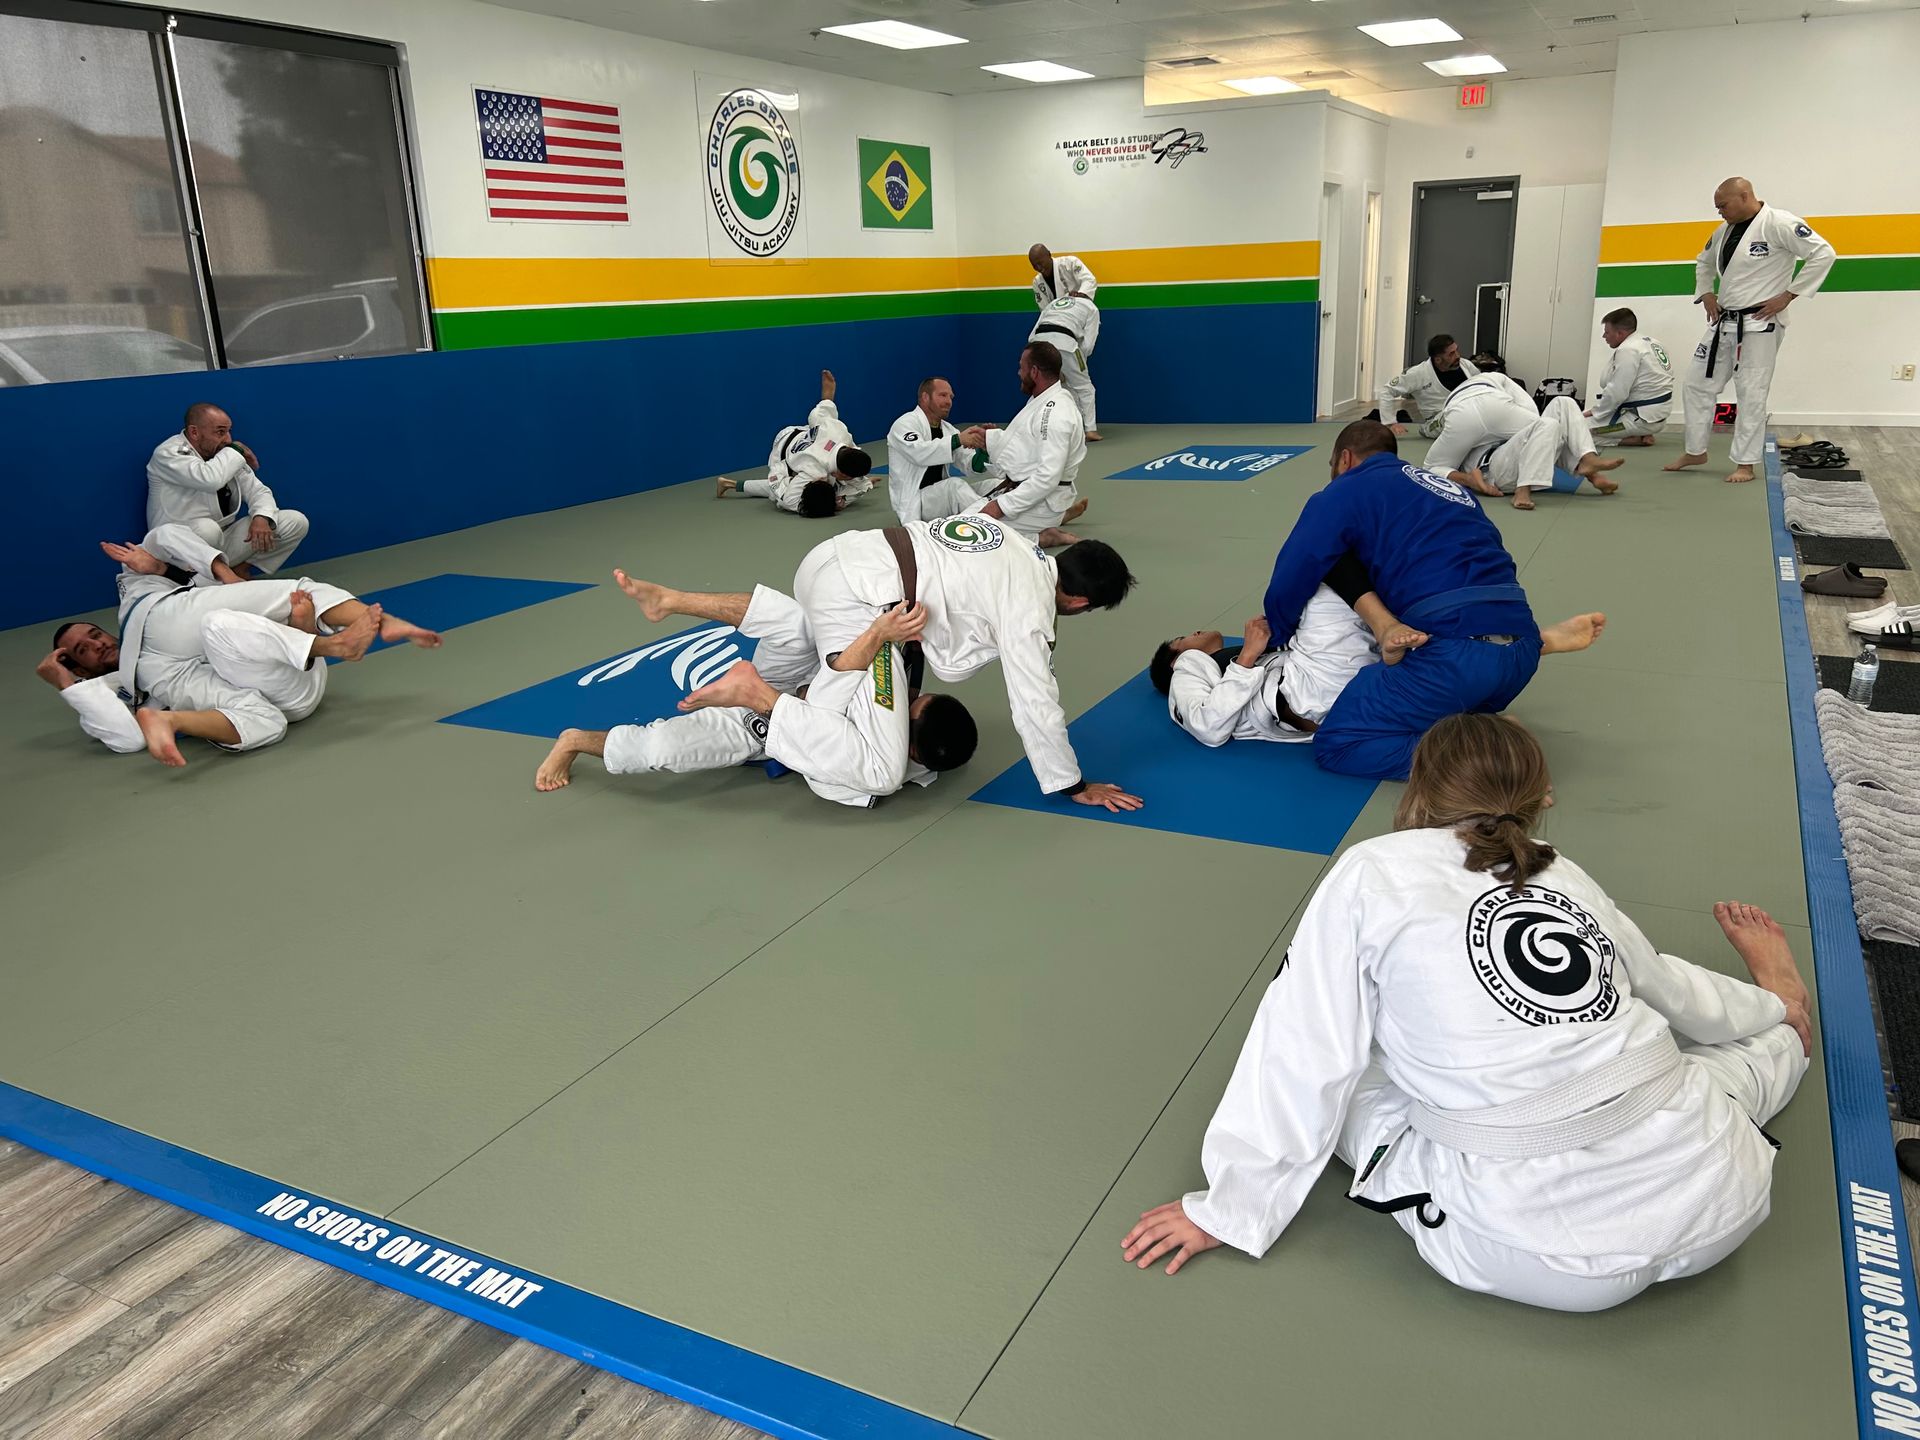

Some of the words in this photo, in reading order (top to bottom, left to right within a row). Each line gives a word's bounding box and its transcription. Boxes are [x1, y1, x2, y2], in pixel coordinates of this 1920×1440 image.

[1462, 86, 1486, 106] EXIT
[711, 95, 755, 168] CHARLES
[759, 101, 797, 174] GRACIE
[1055, 142, 1061, 150] A
[1063, 140, 1088, 149] BLACK
[1090, 138, 1109, 147] BELT
[1110, 137, 1118, 145] IS
[1120, 136, 1126, 144] A
[1067, 149, 1085, 158] WHO
[1086, 147, 1112, 156] NEVER
[1113, 145, 1137, 154] GIVES
[714, 188, 759, 251] JIU-JITSU
[762, 192, 798, 251] ACADEMY
[1473, 889, 1534, 948] CHARLES
[1544, 893, 1611, 957] GRACIE
[1478, 959, 1560, 1025] JIU-JITSU
[1850, 1182, 1895, 1230] MAT
[256, 1192, 309, 1221] NO
[294, 1206, 390, 1252] SHOES
[376, 1236, 431, 1267] ON
[415, 1248, 483, 1287] THE
[465, 1267, 544, 1309] MAT
[1855, 1226, 1900, 1270] THE
[1859, 1268, 1906, 1306] ON
[1862, 1304, 1918, 1393] SHOES
[1871, 1391, 1920, 1440] NO
